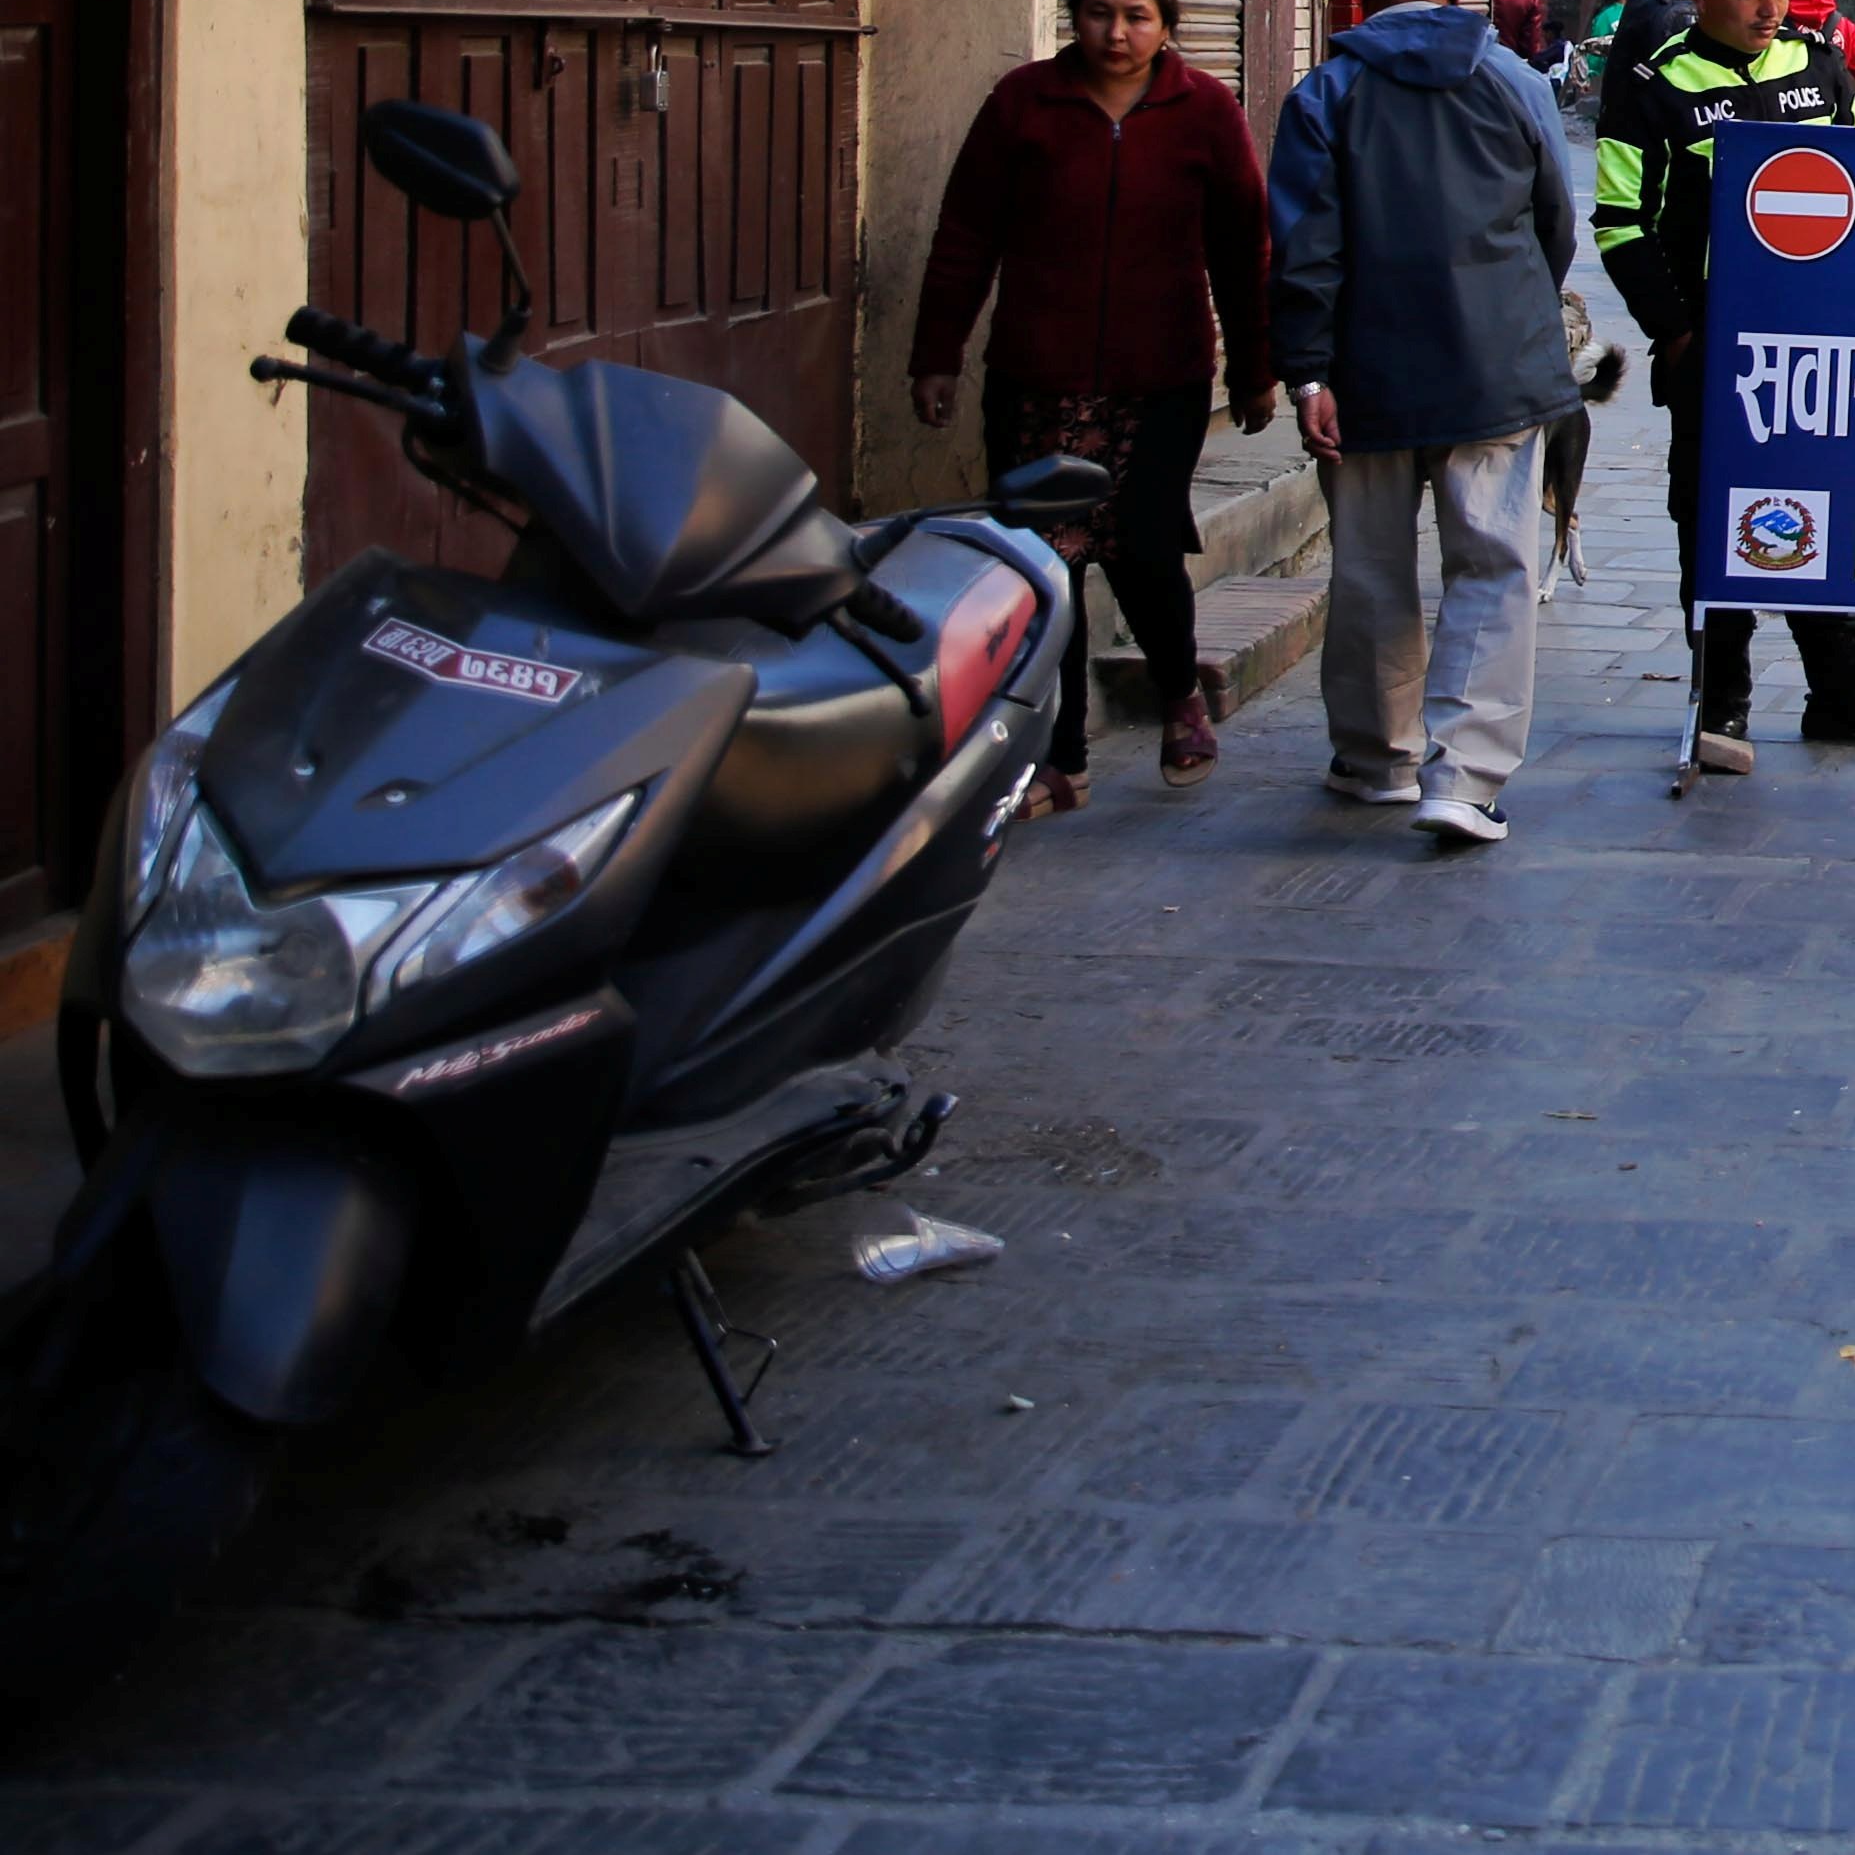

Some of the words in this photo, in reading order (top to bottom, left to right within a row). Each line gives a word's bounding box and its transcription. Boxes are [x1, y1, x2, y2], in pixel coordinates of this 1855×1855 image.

[1694, 99, 1736, 127] LMC
[1778, 86, 1824, 114] POLICE
[459, 655, 559, 696] ७६४१
